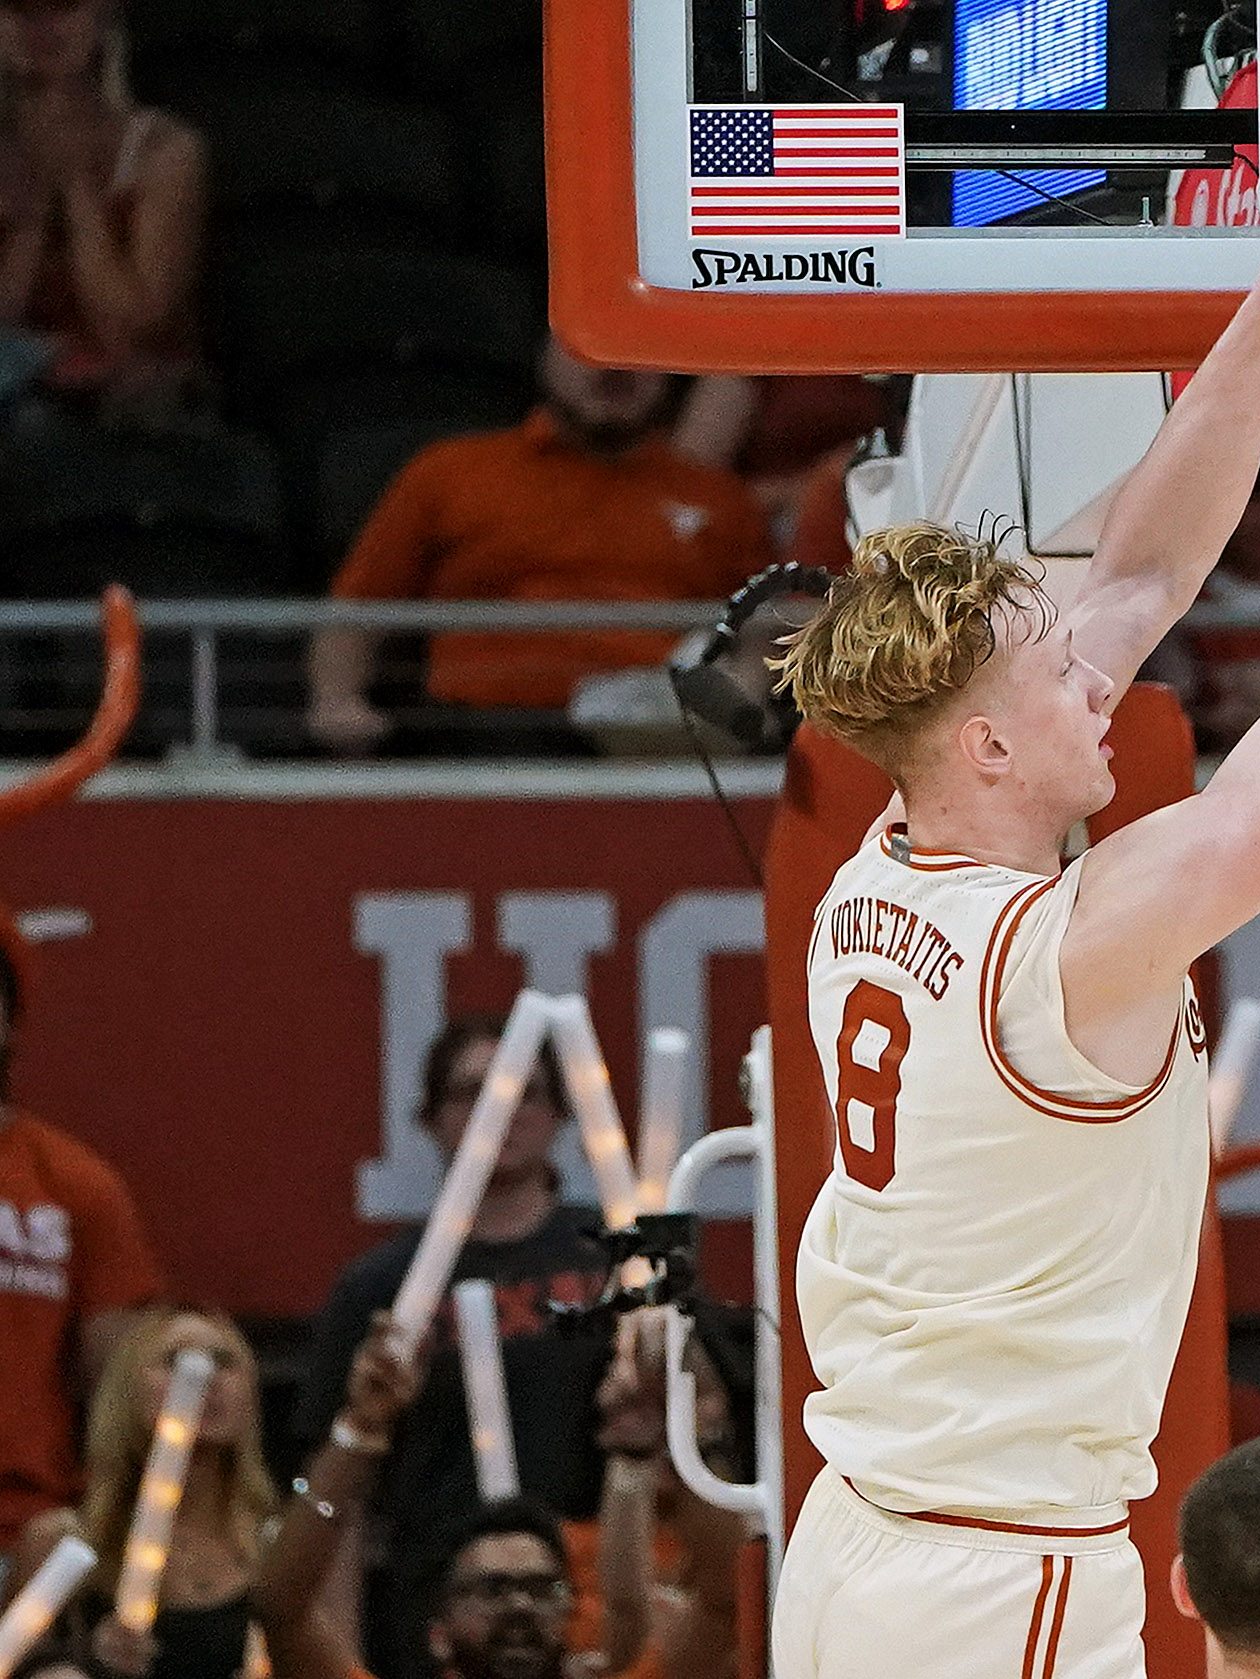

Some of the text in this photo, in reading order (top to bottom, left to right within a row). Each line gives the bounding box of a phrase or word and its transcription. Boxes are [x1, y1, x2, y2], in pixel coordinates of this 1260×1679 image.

[692, 246, 876, 289] SPALDING
[831, 897, 965, 1001] VOKIETAITIS
[835, 978, 911, 1192] 8
